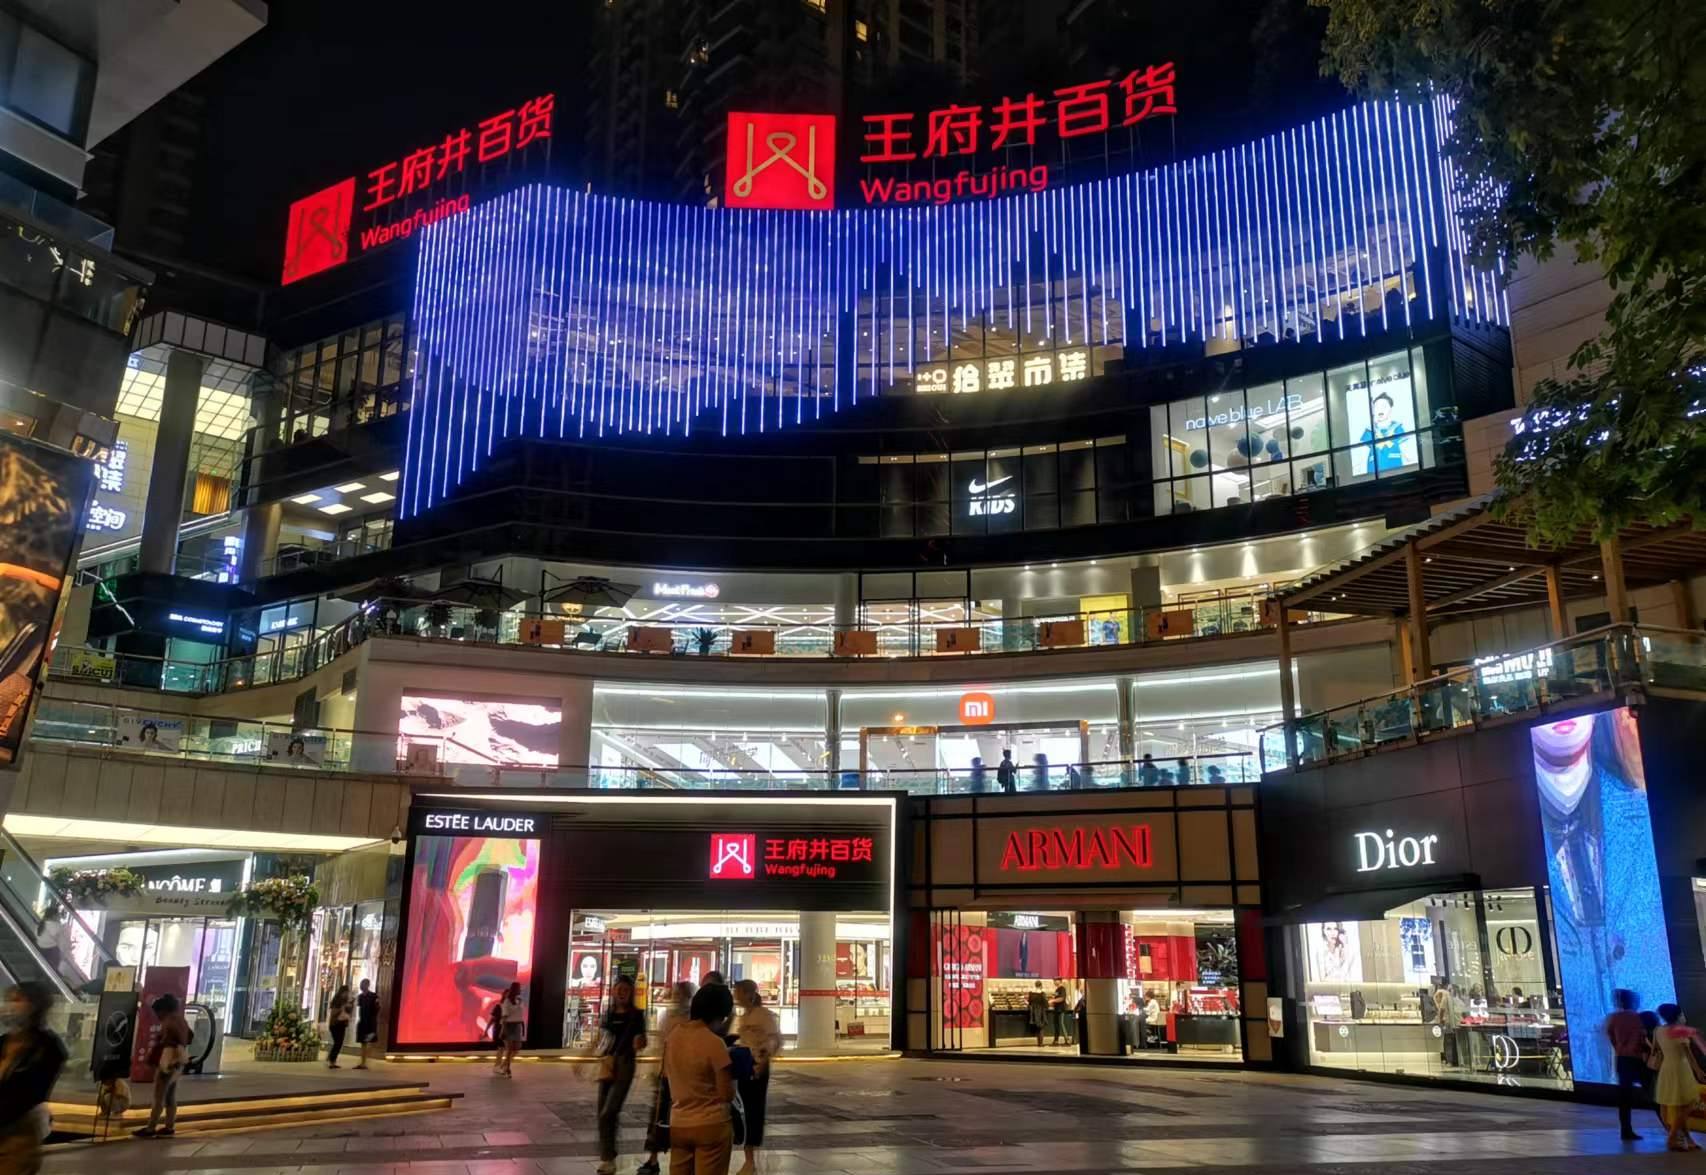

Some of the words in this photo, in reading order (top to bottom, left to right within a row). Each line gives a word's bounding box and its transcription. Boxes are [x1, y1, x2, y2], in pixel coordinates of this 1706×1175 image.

[860, 62, 1177, 162] 王府井百货
[363, 93, 555, 211] 王府井百货
[861, 165, 1048, 205] Wangfujing
[361, 194, 470, 249] Wangfujing
[1185, 411, 1228, 431] nave
[1268, 393, 1304, 415] LAB
[968, 494, 1016, 516] KIDS
[473, 816, 535, 832] LAUDER
[764, 837, 873, 863] 王府井百货
[1001, 825, 1153, 872] ARMANI
[1353, 828, 1438, 872] Dior
[764, 864, 837, 879] Wangfujing
